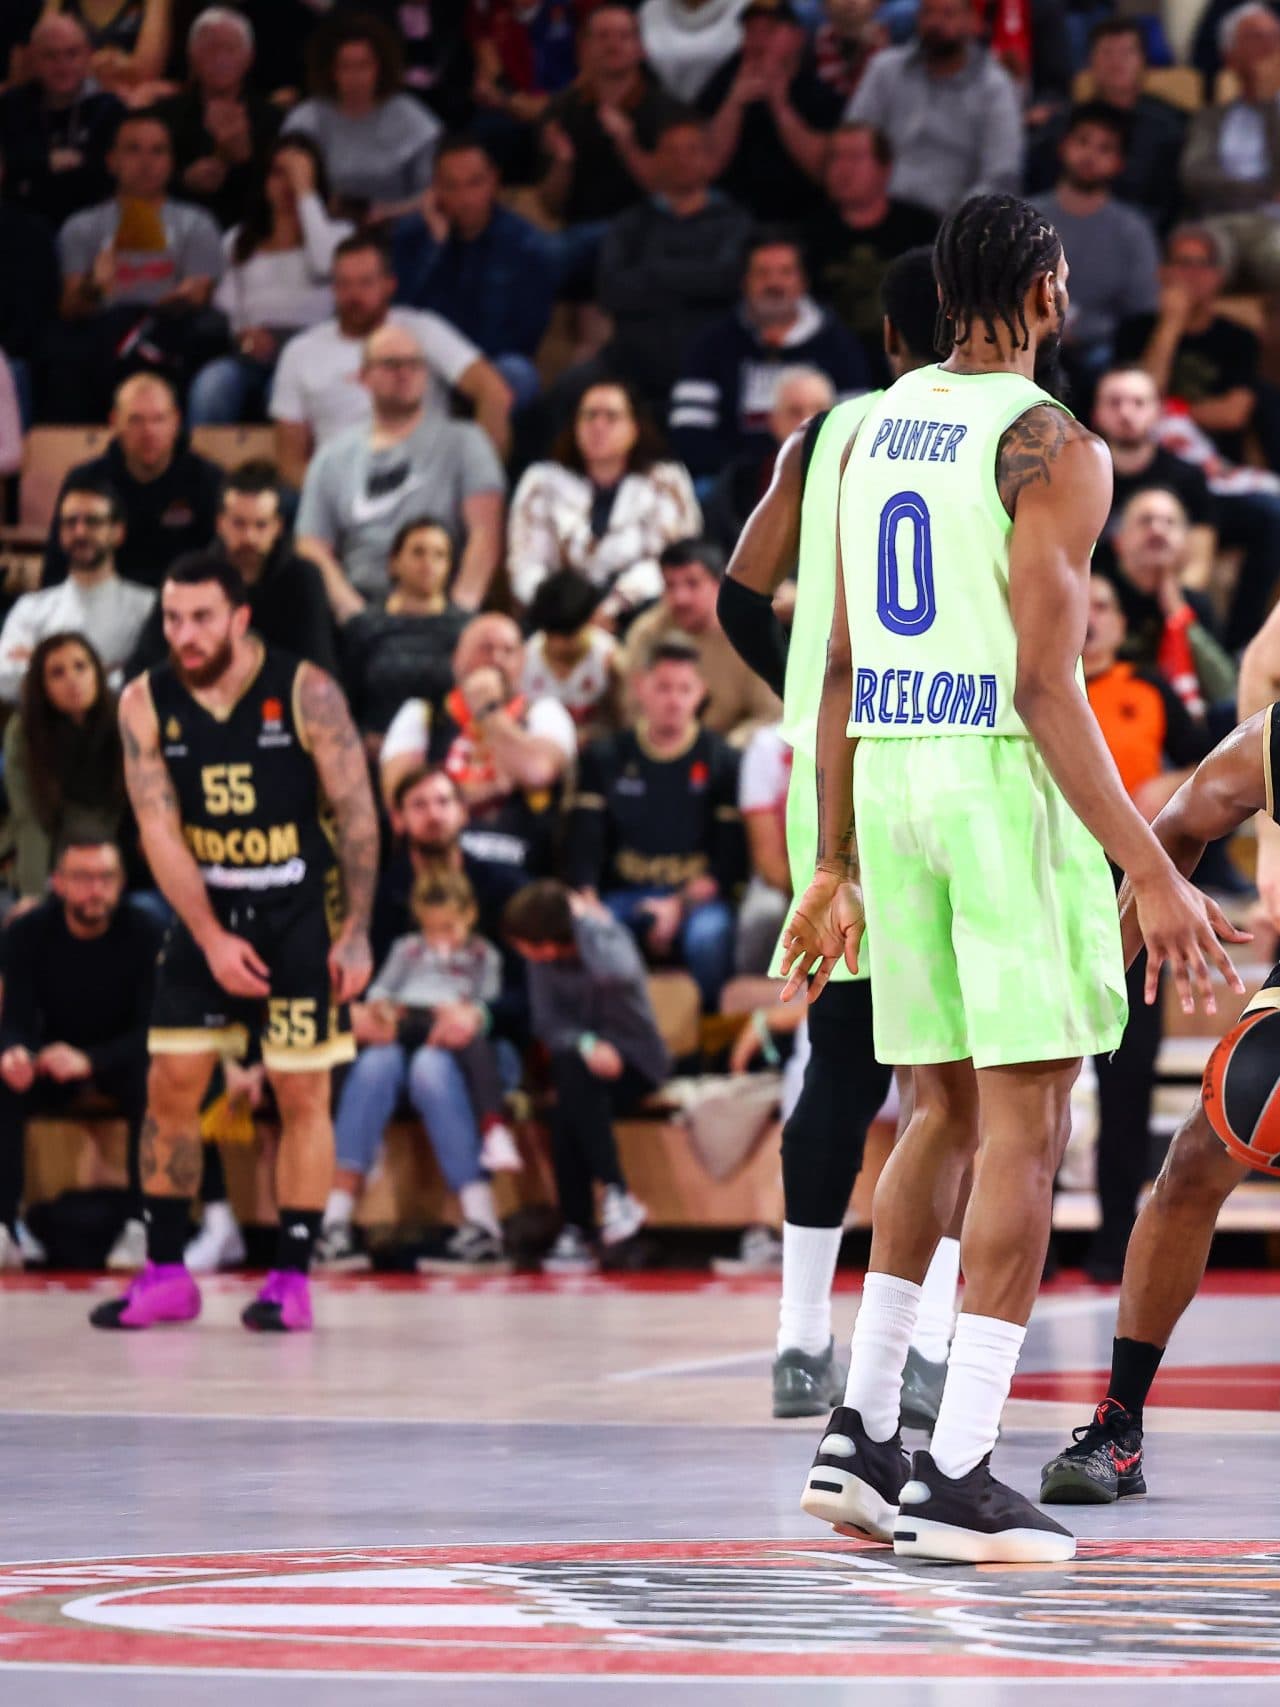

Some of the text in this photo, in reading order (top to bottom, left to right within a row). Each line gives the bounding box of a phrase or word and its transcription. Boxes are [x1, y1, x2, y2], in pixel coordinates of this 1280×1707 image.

[870, 418, 968, 463] PUNTER
[876, 490, 937, 637] 0
[852, 667, 997, 728] RCELONA
[201, 763, 257, 816] 55
[268, 998, 317, 1046] 55
